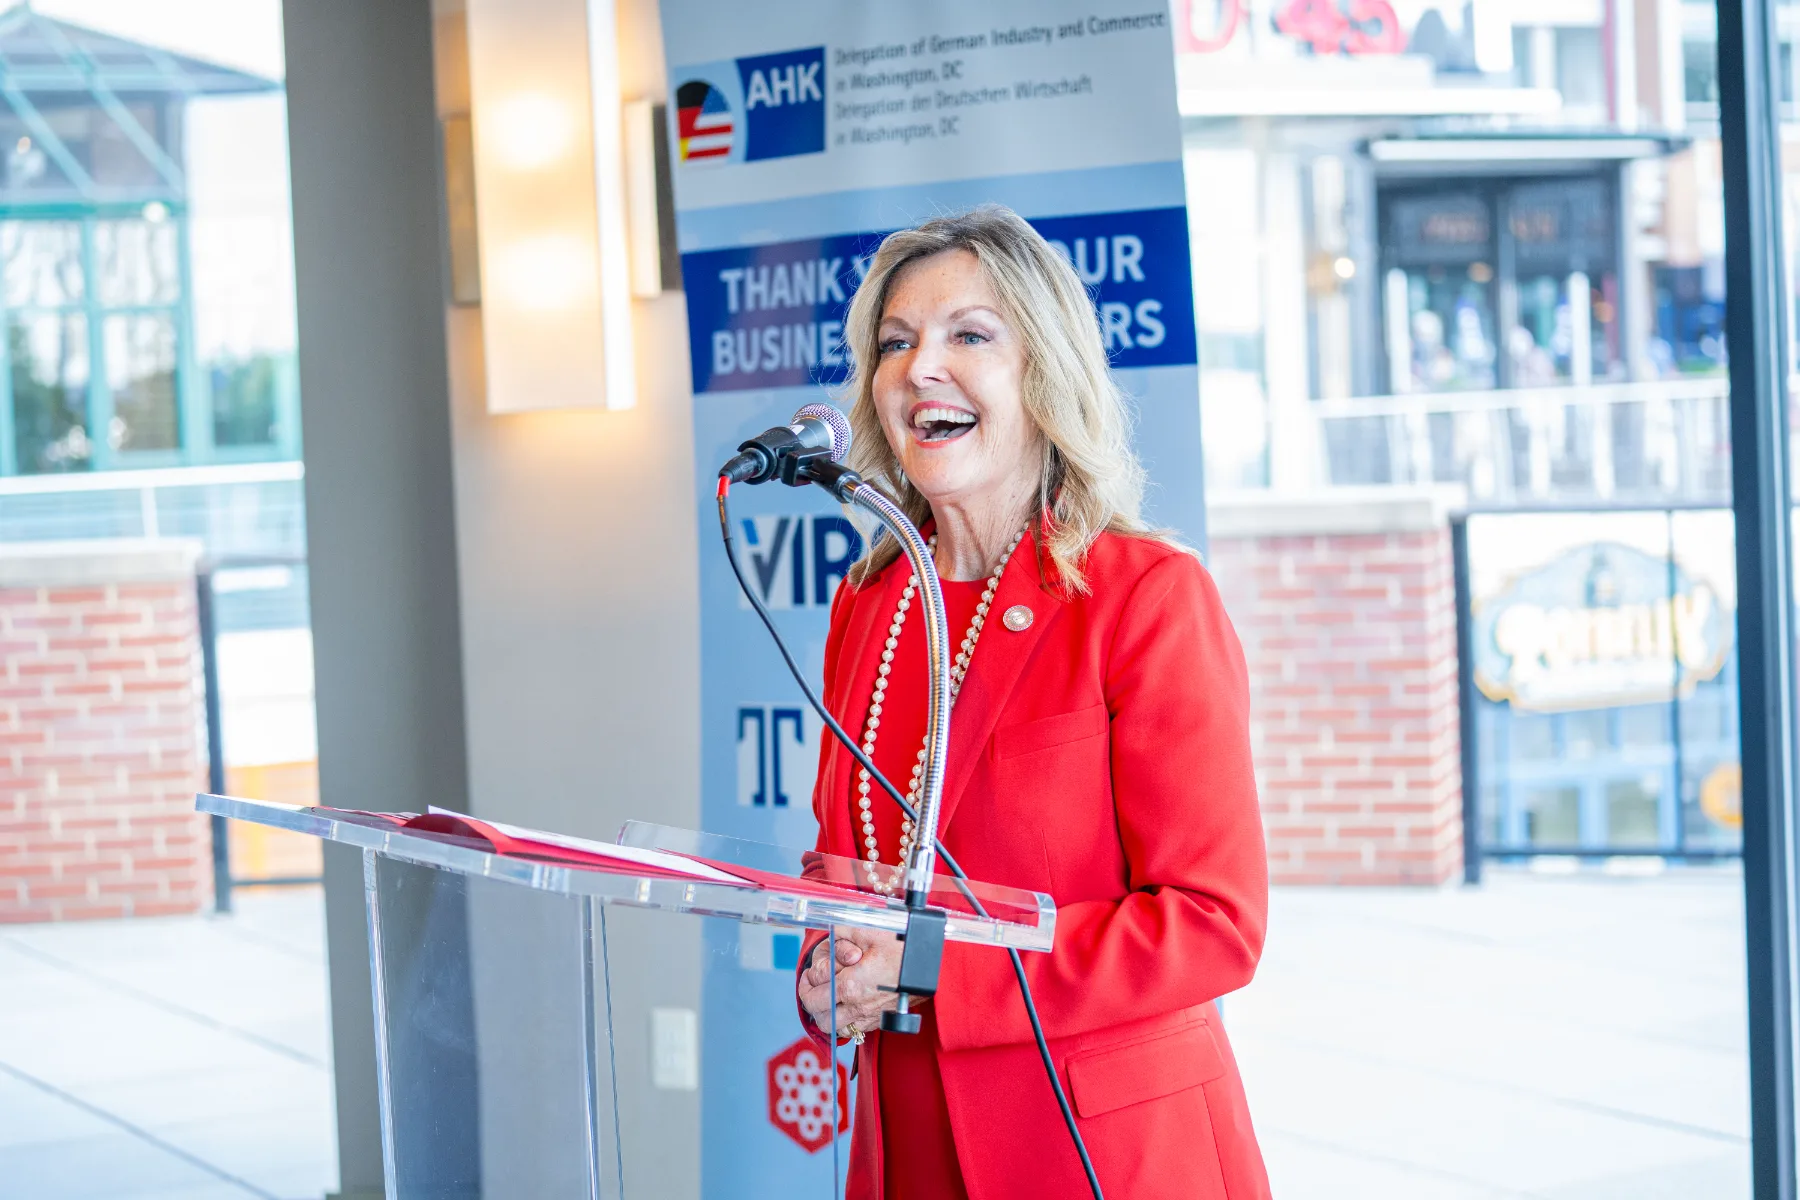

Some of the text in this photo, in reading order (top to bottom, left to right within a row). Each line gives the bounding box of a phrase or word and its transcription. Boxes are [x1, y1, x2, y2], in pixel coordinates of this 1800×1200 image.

[835, 44, 907, 66] Delegation
[910, 35, 926, 57] of
[929, 33, 987, 54] German
[991, 25, 1054, 47] Industry
[1057, 18, 1085, 39] and
[1087, 11, 1165, 36] Commerce
[746, 61, 822, 110] AHK
[835, 73, 1093, 121] Delegation der Deutschen Wirtschaft
[850, 67, 939, 90] Washington,
[942, 59, 964, 80] DC
[850, 122, 937, 146] Washington,
[939, 115, 961, 137] DC
[718, 256, 846, 315] THANK
[711, 298, 1167, 376] BUSINE RS
[740, 515, 864, 605] VIR
